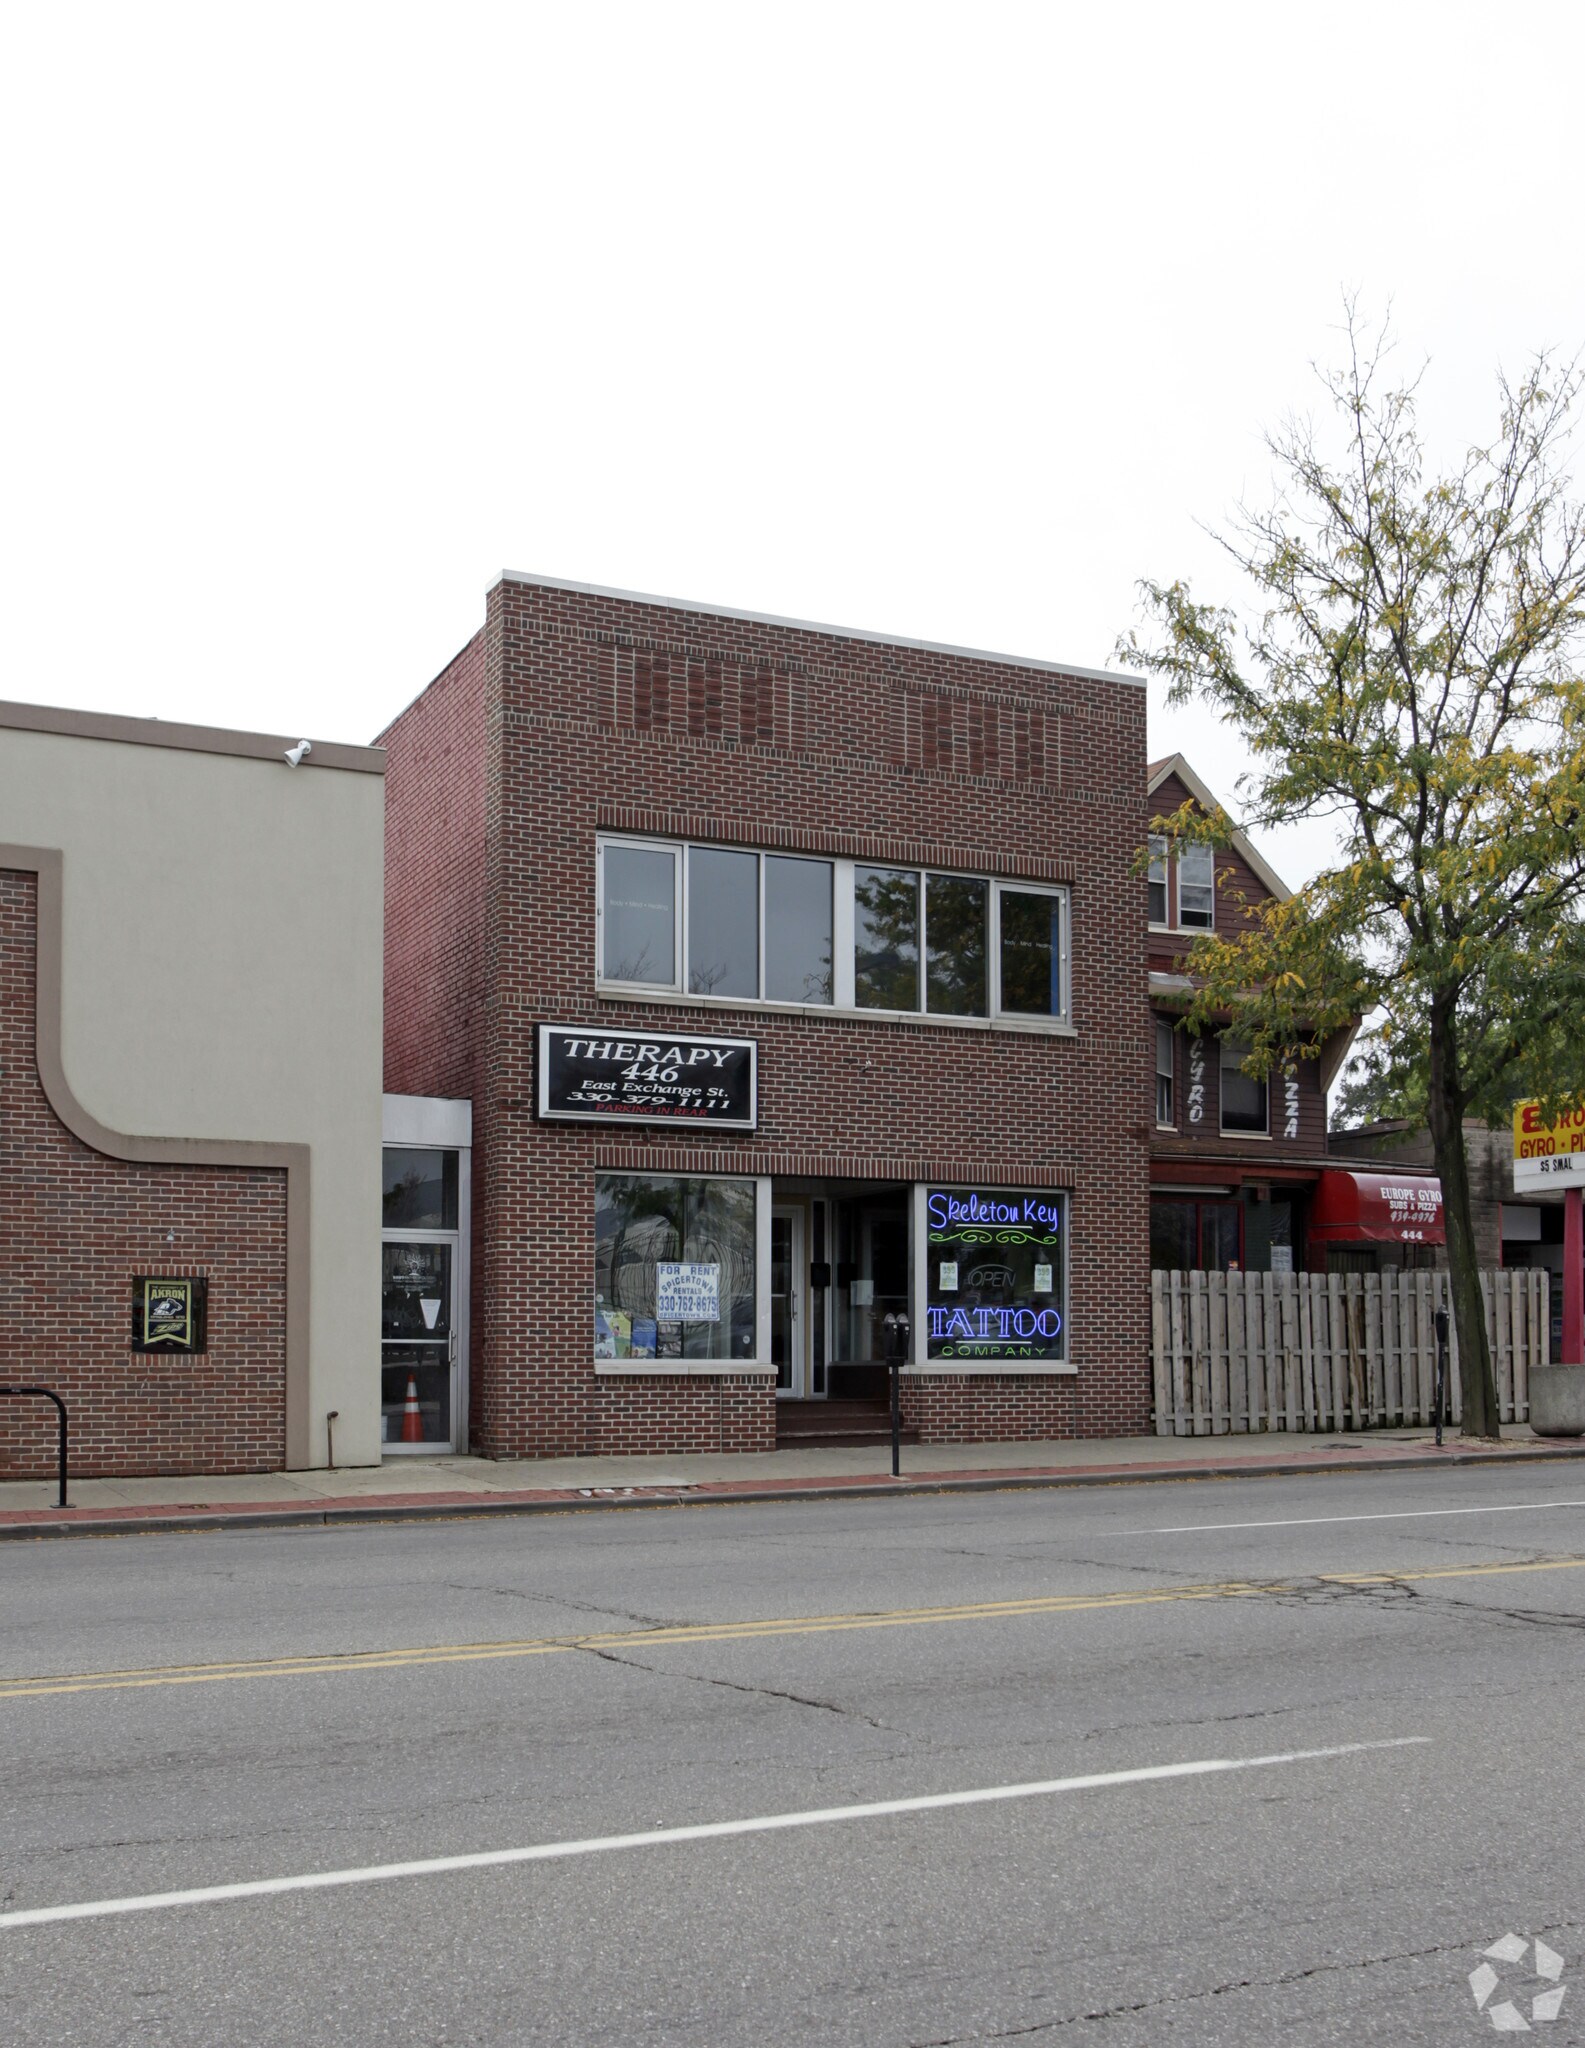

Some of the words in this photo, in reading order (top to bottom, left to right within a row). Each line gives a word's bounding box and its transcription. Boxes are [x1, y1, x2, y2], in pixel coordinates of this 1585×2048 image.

[564, 1039, 735, 1067] THERAPY
[621, 1063, 680, 1083] 446
[581, 1080, 617, 1091] East
[622, 1083, 702, 1097] Exchange
[706, 1087, 729, 1097] St.
[595, 1103, 653, 1114] PARKING
[656, 1106, 671, 1115] IN
[673, 1108, 708, 1117] REAR
[1520, 1136, 1556, 1159] GYRO
[1571, 1132, 1585, 1154] PI
[1380, 1187, 1416, 1201] EUROPE
[1418, 1189, 1443, 1203] GYRO
[928, 1193, 1020, 1229] Skeleton
[1023, 1198, 1058, 1232] Key
[1389, 1200, 1408, 1210] SUBS
[1417, 1202, 1437, 1212] PIZZA
[1401, 1230, 1423, 1240] 444
[660, 1265, 680, 1275] FOR
[690, 1266, 717, 1276] RENT
[661, 1275, 715, 1293] SPICERTOWN
[969, 1270, 1016, 1288] OPEN
[150, 1289, 186, 1301] AKRON
[673, 1287, 703, 1295] RENTALS
[927, 1307, 1061, 1338] TATTOO
[941, 1345, 1046, 1357] COMPANY
